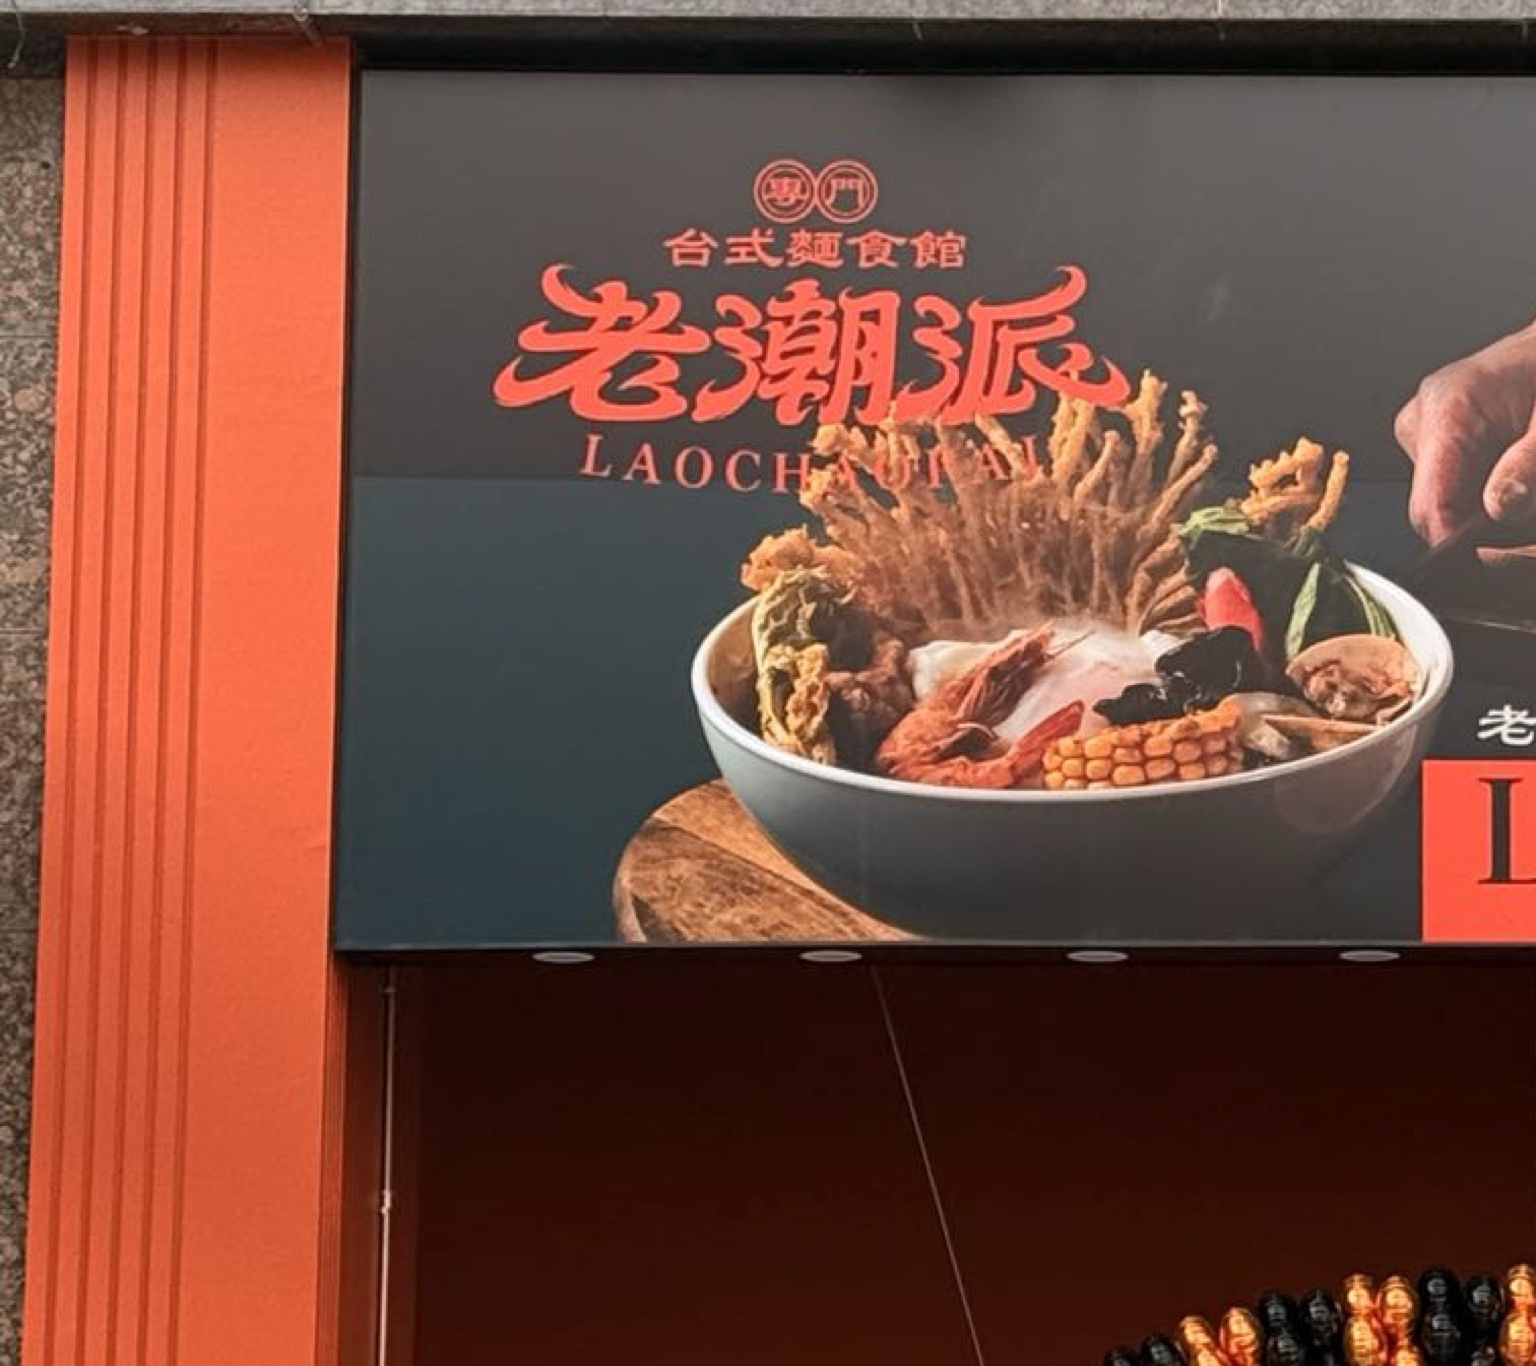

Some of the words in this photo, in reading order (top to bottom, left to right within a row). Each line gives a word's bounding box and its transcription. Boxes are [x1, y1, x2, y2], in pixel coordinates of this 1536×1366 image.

[663, 227, 967, 269] 台式麵食館
[491, 261, 1134, 425] 老潮派
